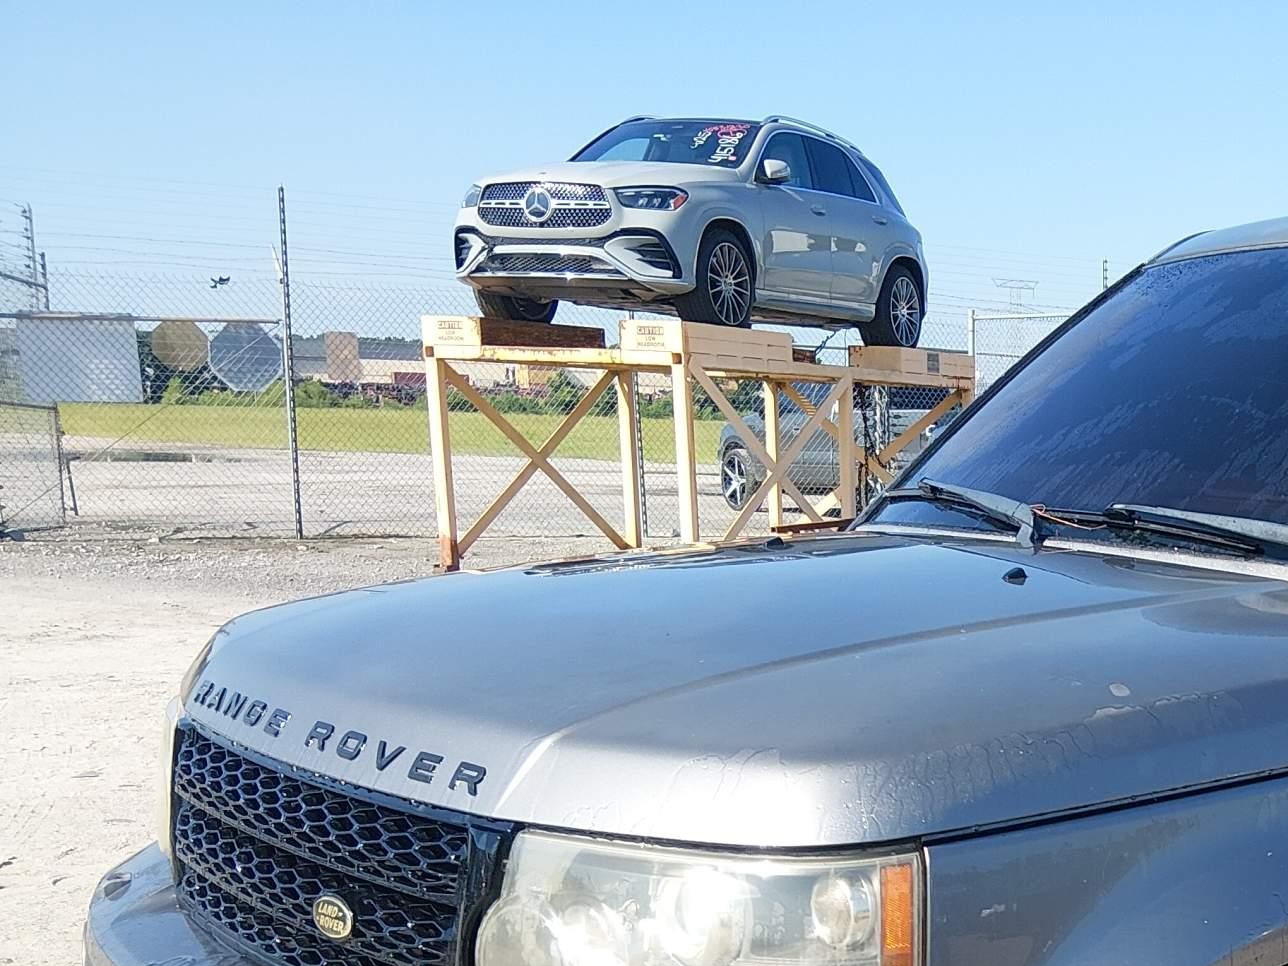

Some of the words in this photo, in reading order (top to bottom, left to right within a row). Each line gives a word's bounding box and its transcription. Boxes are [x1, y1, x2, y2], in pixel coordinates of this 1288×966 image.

[193, 679, 292, 737] RANGE
[304, 720, 488, 796] ROVER
[317, 901, 338, 917] LAND
[319, 914, 345, 932] ROVER
